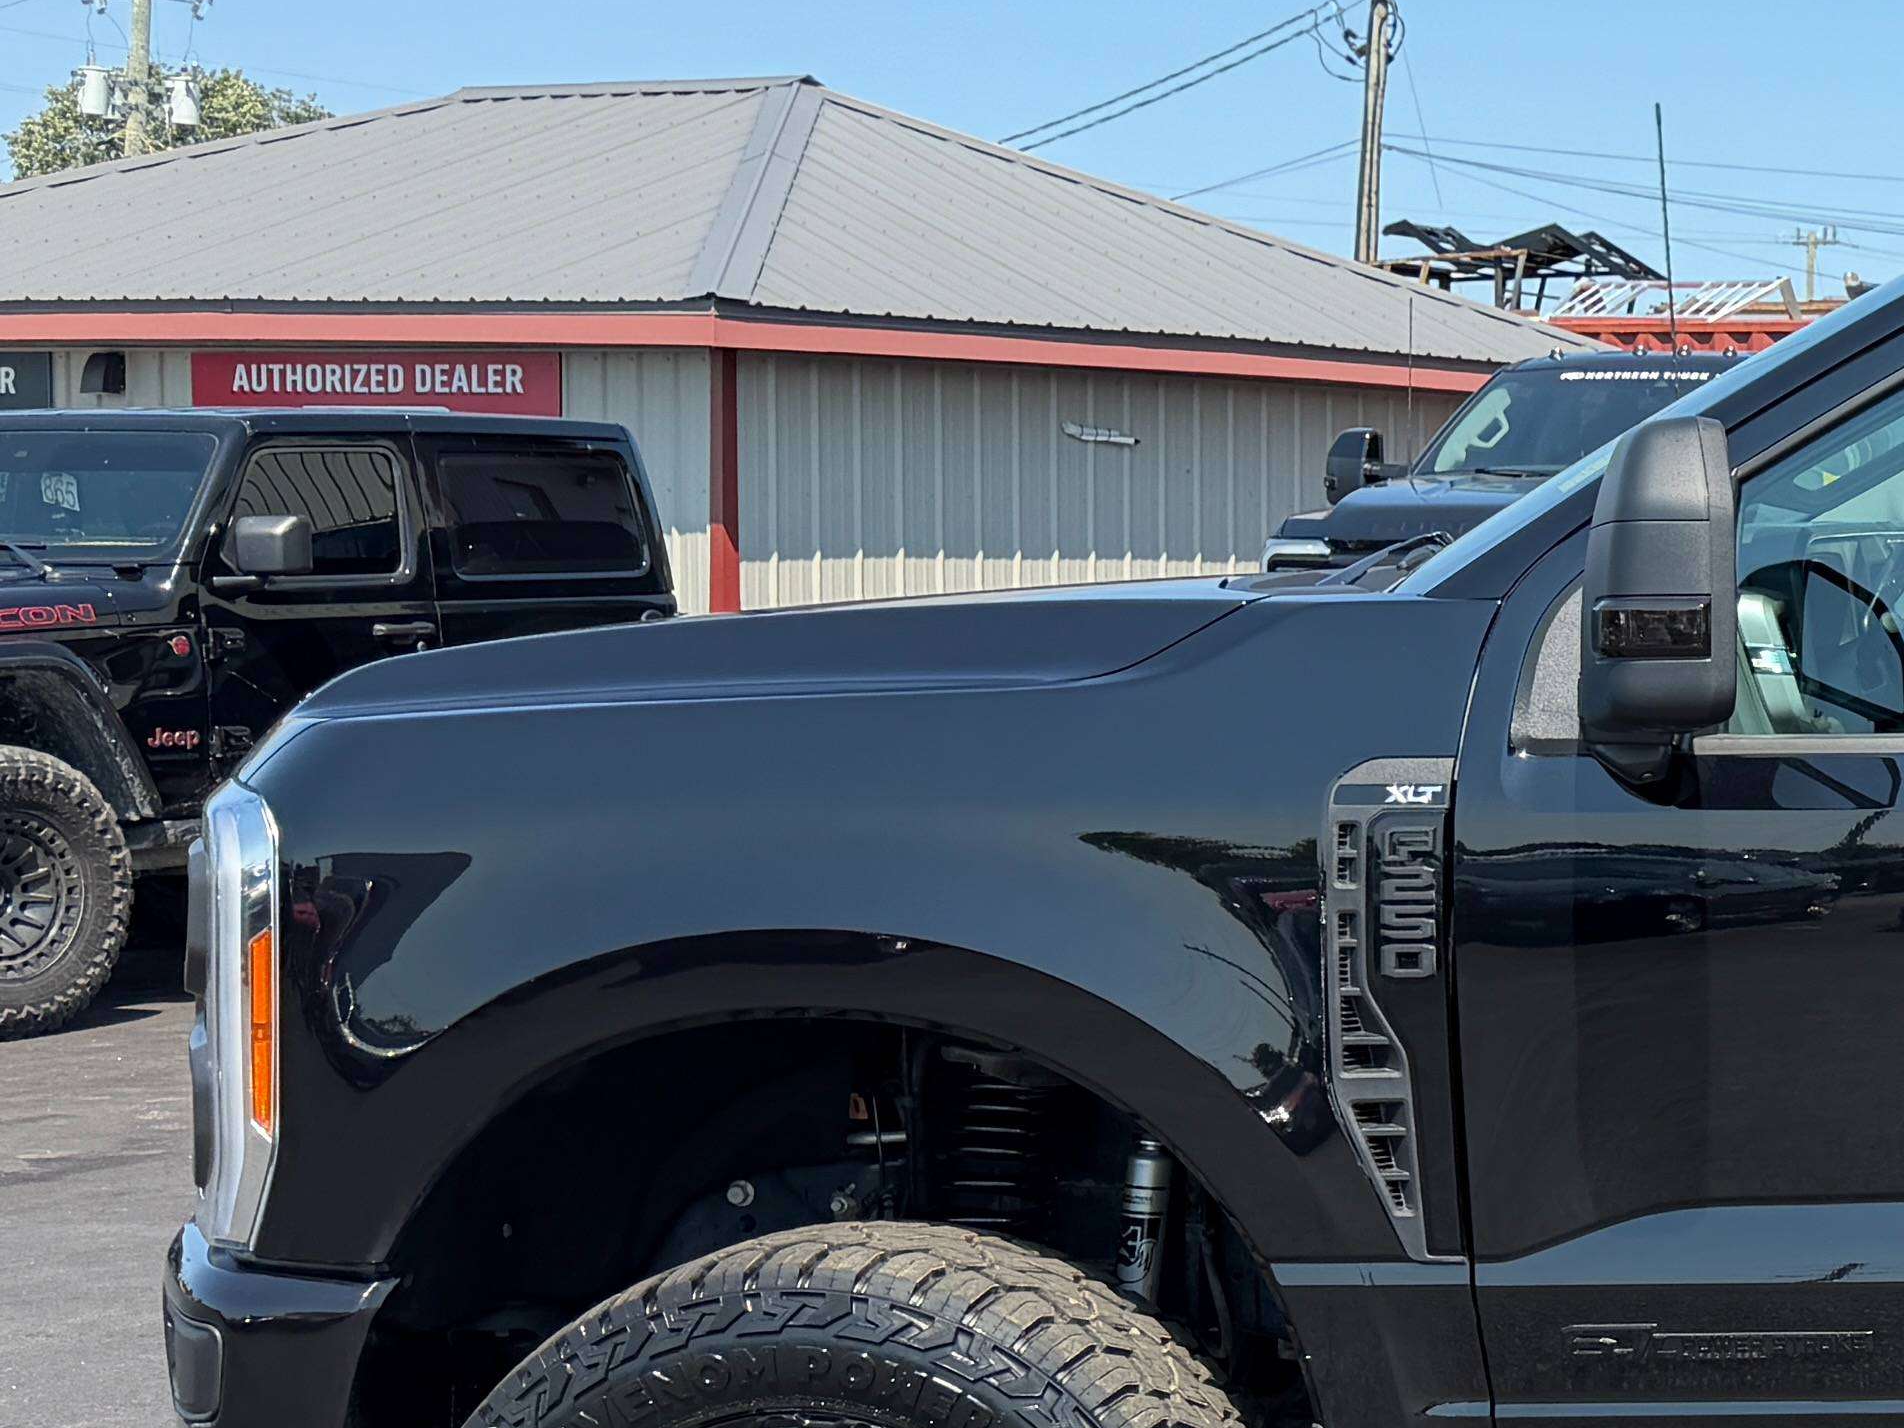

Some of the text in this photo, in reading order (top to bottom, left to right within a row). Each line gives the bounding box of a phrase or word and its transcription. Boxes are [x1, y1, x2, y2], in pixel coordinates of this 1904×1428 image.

[232, 363, 524, 395] AUTHORIZED DEALER
[147, 727, 200, 750] Jeep
[1385, 783, 1443, 804] XLT
